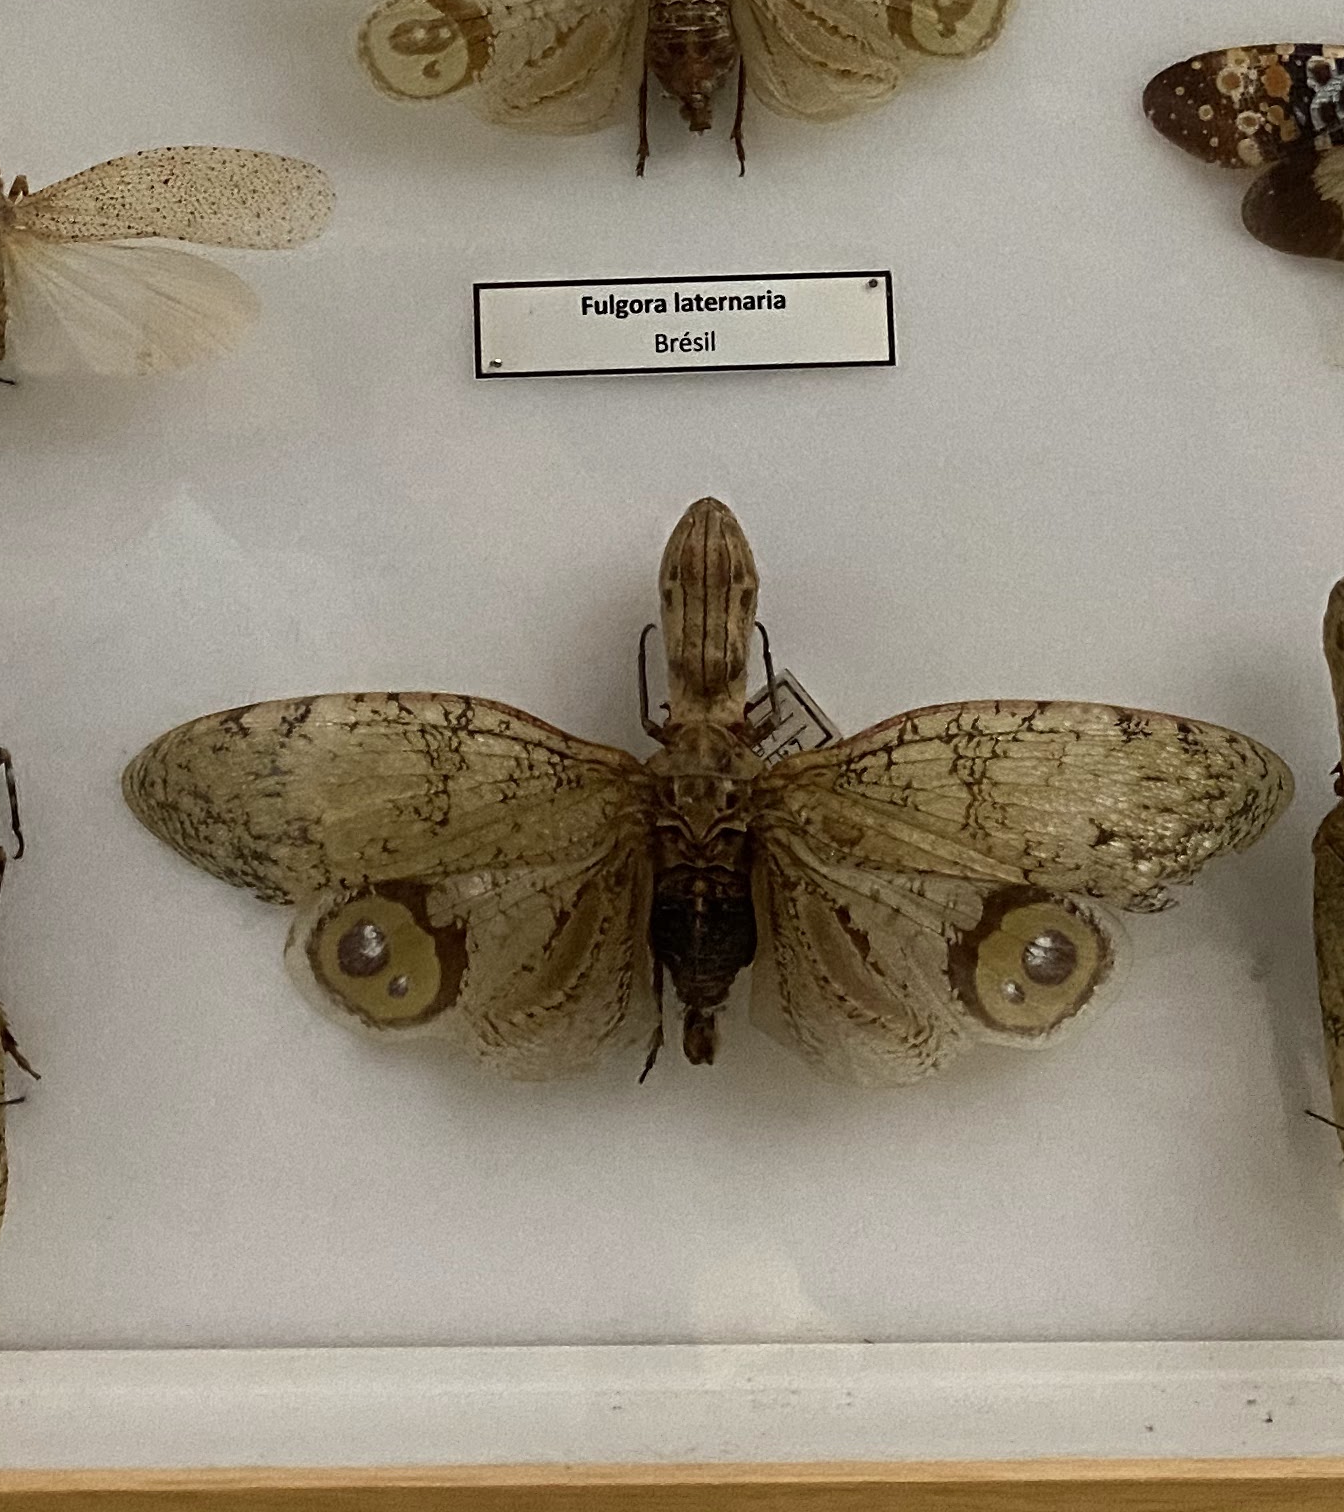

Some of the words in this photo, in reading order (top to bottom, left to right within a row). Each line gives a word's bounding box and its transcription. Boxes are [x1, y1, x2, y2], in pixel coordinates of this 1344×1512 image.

[581, 294, 667, 320] Fulgora
[674, 289, 787, 314] laternaria
[654, 329, 717, 354] Brésil
